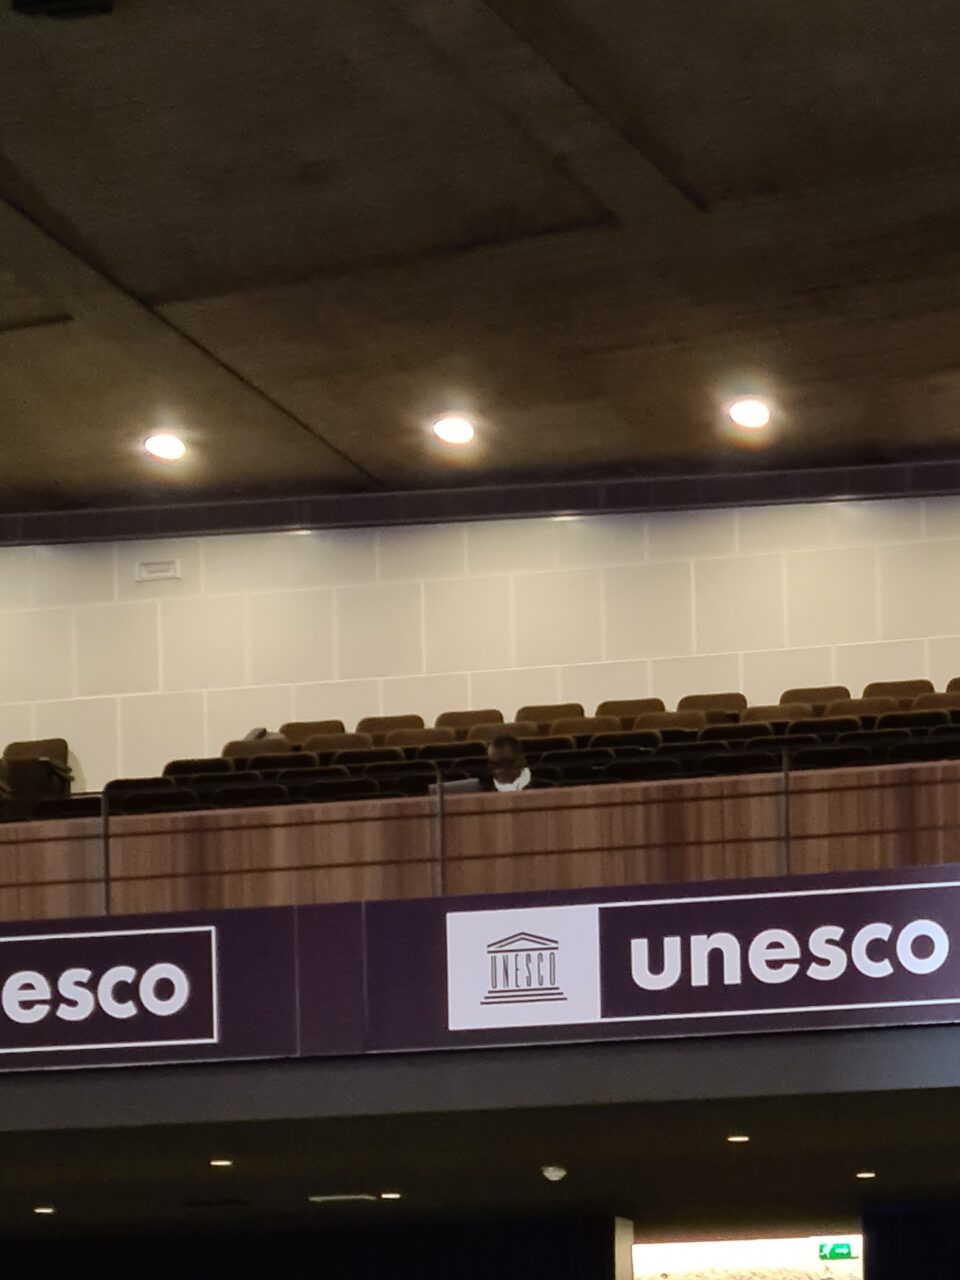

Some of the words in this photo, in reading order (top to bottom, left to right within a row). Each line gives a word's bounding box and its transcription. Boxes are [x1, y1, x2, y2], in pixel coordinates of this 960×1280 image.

[490, 951, 556, 989] UNESCO
[630, 919, 949, 991] unesco
[2, 962, 189, 1024] esco
